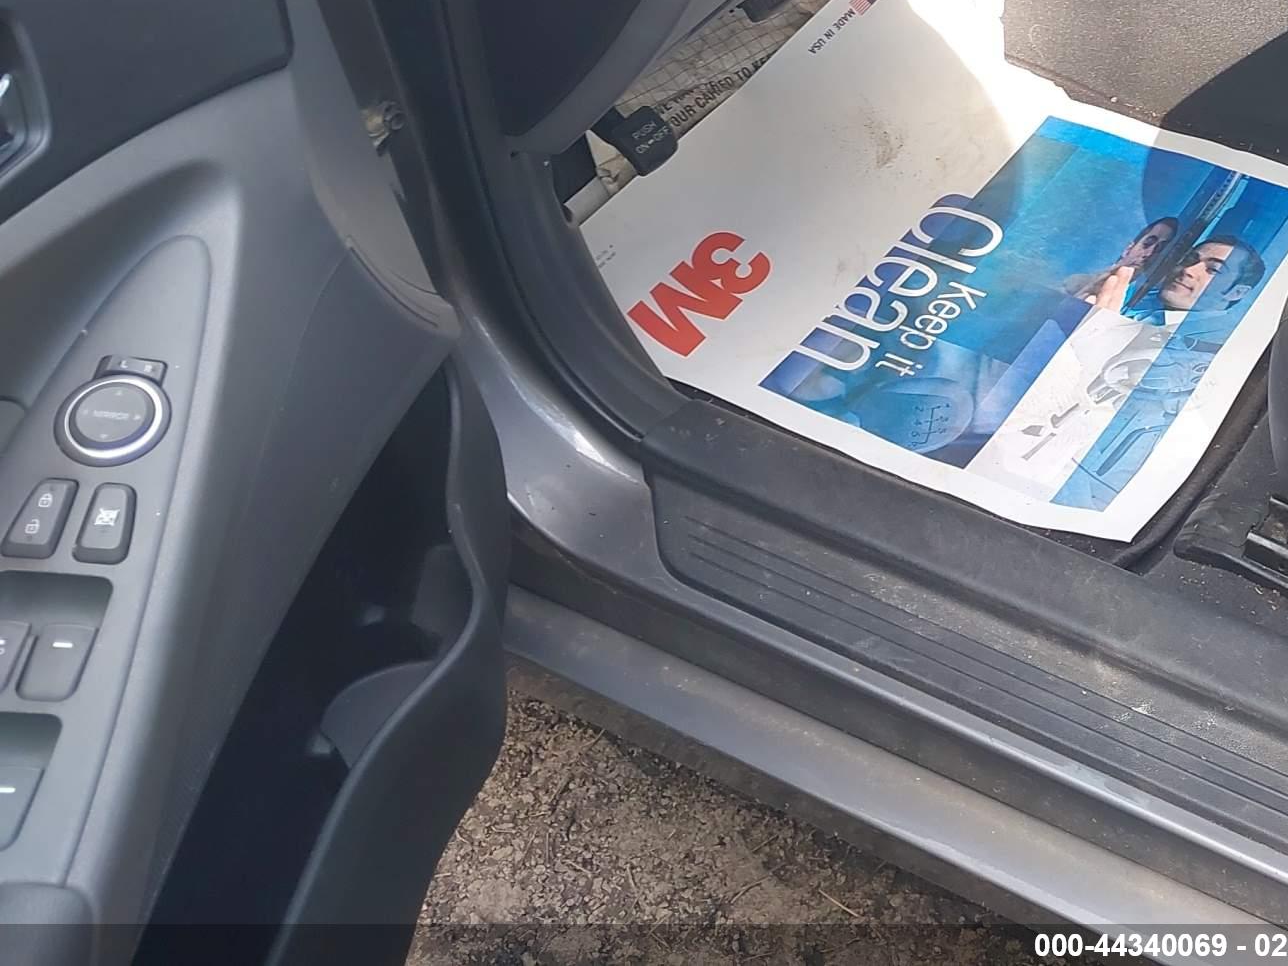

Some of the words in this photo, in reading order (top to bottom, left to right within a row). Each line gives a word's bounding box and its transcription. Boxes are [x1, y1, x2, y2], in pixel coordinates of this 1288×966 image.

[832, 8, 856, 30] MADE
[823, 28, 836, 40] IN
[808, 38, 827, 54] USA
[632, 121, 657, 140] PUSH
[627, 232, 770, 356] 3M
[799, 206, 1004, 371] Clean
[898, 281, 988, 350] Keep
[875, 352, 924, 377] it
